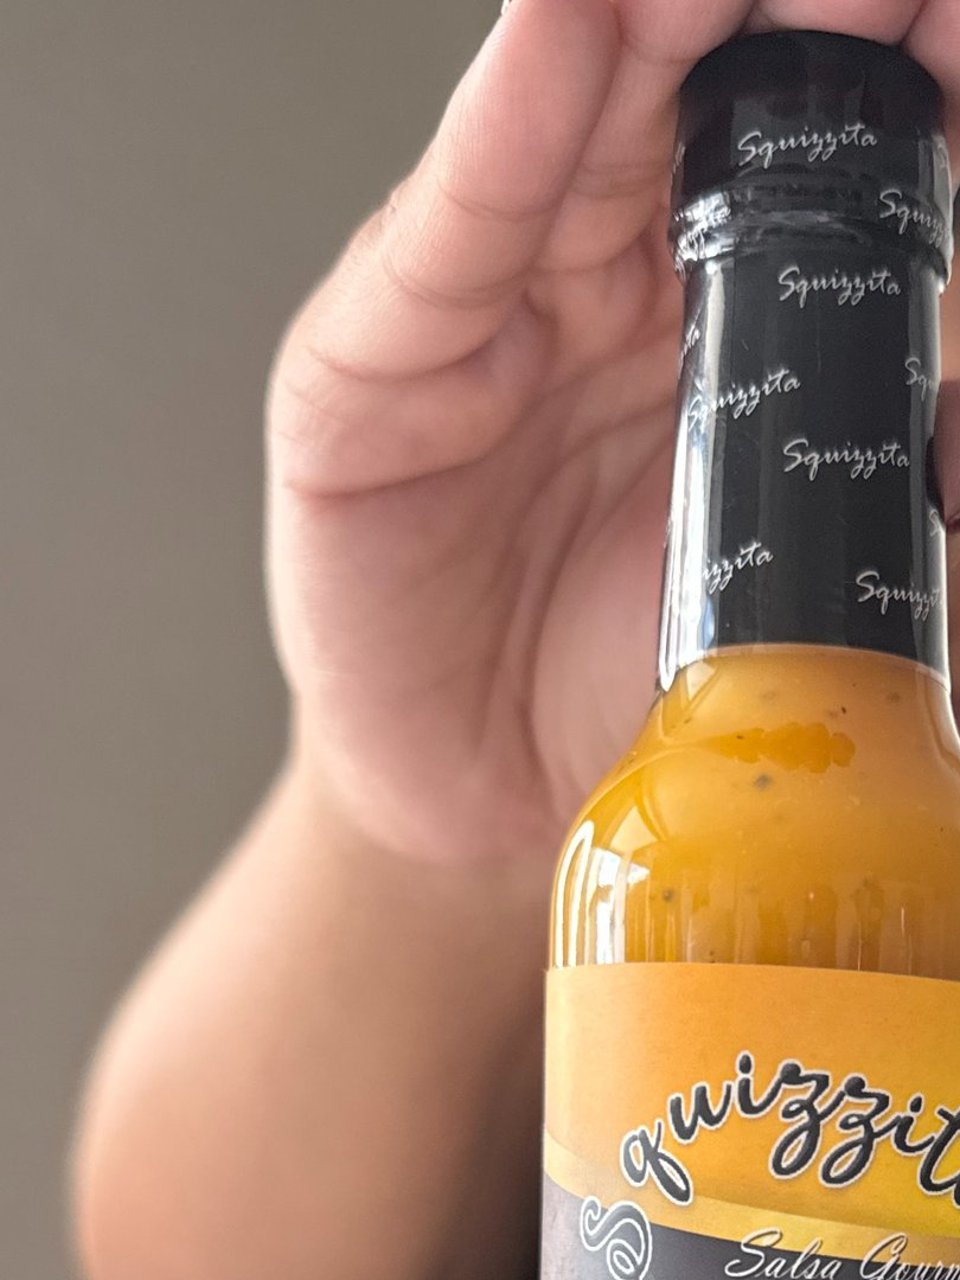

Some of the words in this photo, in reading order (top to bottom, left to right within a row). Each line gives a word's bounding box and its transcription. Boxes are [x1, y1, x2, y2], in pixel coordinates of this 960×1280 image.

[737, 121, 878, 168] Squizzita
[879, 188, 944, 249] Squizz
[778, 265, 901, 308] Squizzita
[783, 437, 911, 481] Squizzita
[702, 541, 774, 595] izzita
[856, 570, 941, 621] Squizzit
[724, 1226, 843, 1280] Salsa
